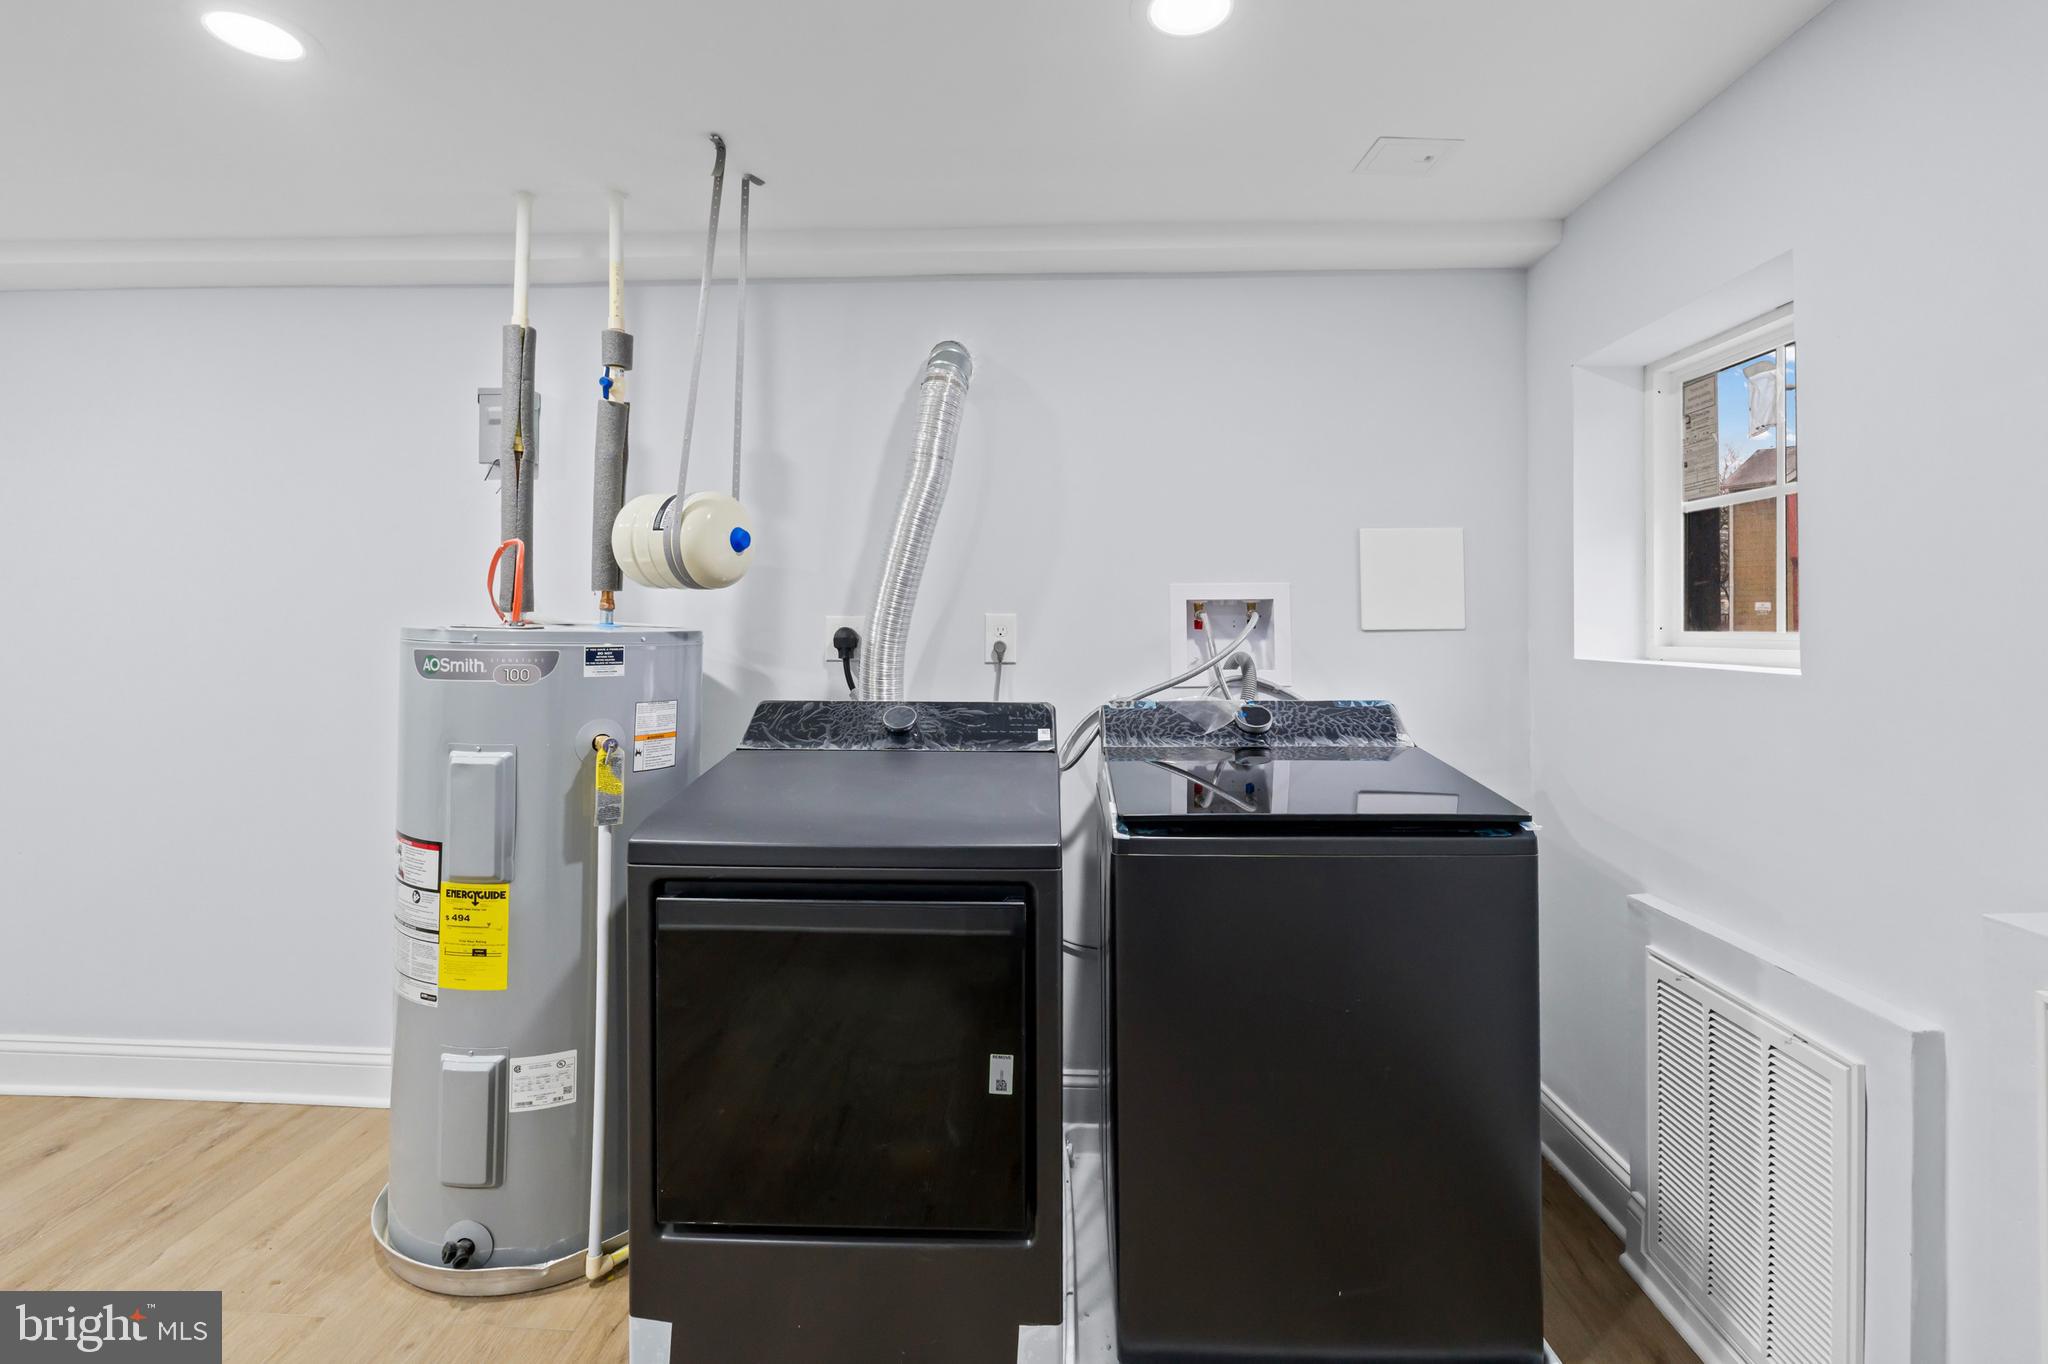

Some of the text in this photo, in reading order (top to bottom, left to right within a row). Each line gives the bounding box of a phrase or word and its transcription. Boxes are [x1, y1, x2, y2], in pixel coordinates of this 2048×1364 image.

[503, 668, 531, 682] 100
[445, 888, 507, 900] ENERGYGUIDE
[451, 914, 471, 922] 494
